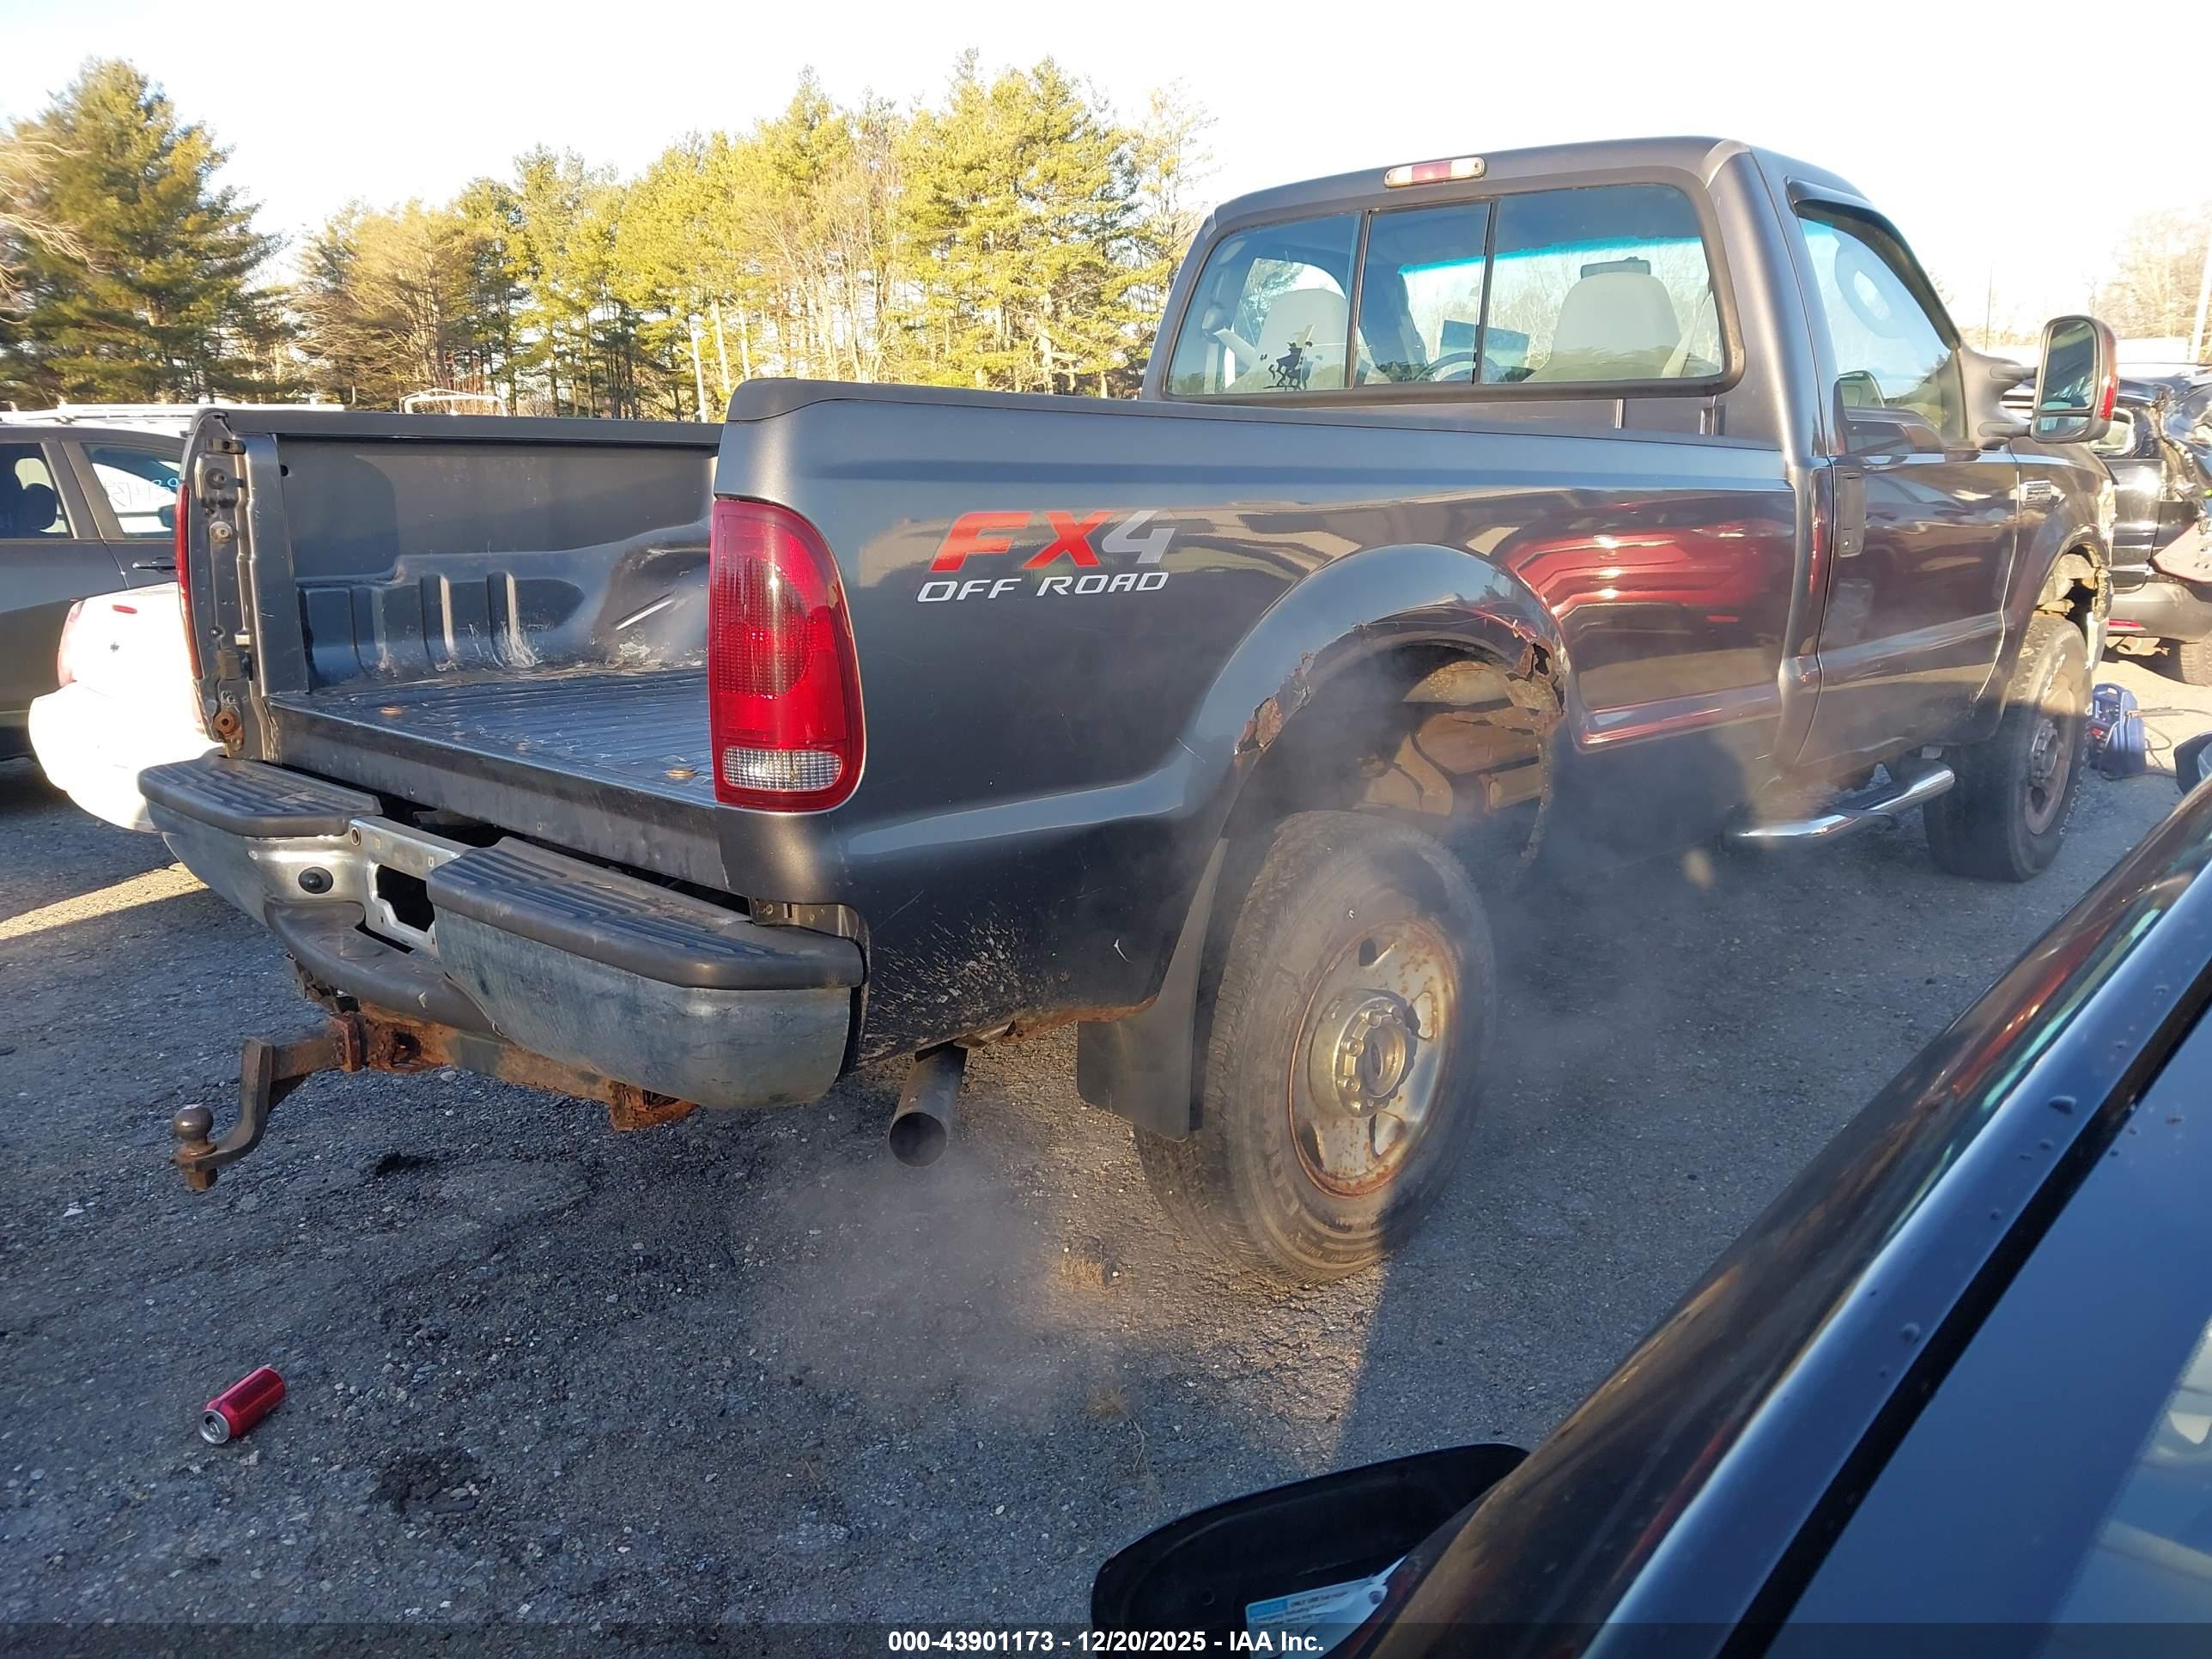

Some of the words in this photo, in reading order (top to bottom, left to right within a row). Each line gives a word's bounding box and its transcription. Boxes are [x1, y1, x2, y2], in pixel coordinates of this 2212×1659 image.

[929, 510, 1176, 573] FX4
[917, 578, 1022, 602] OFF
[1036, 572, 1169, 597] ROAD
